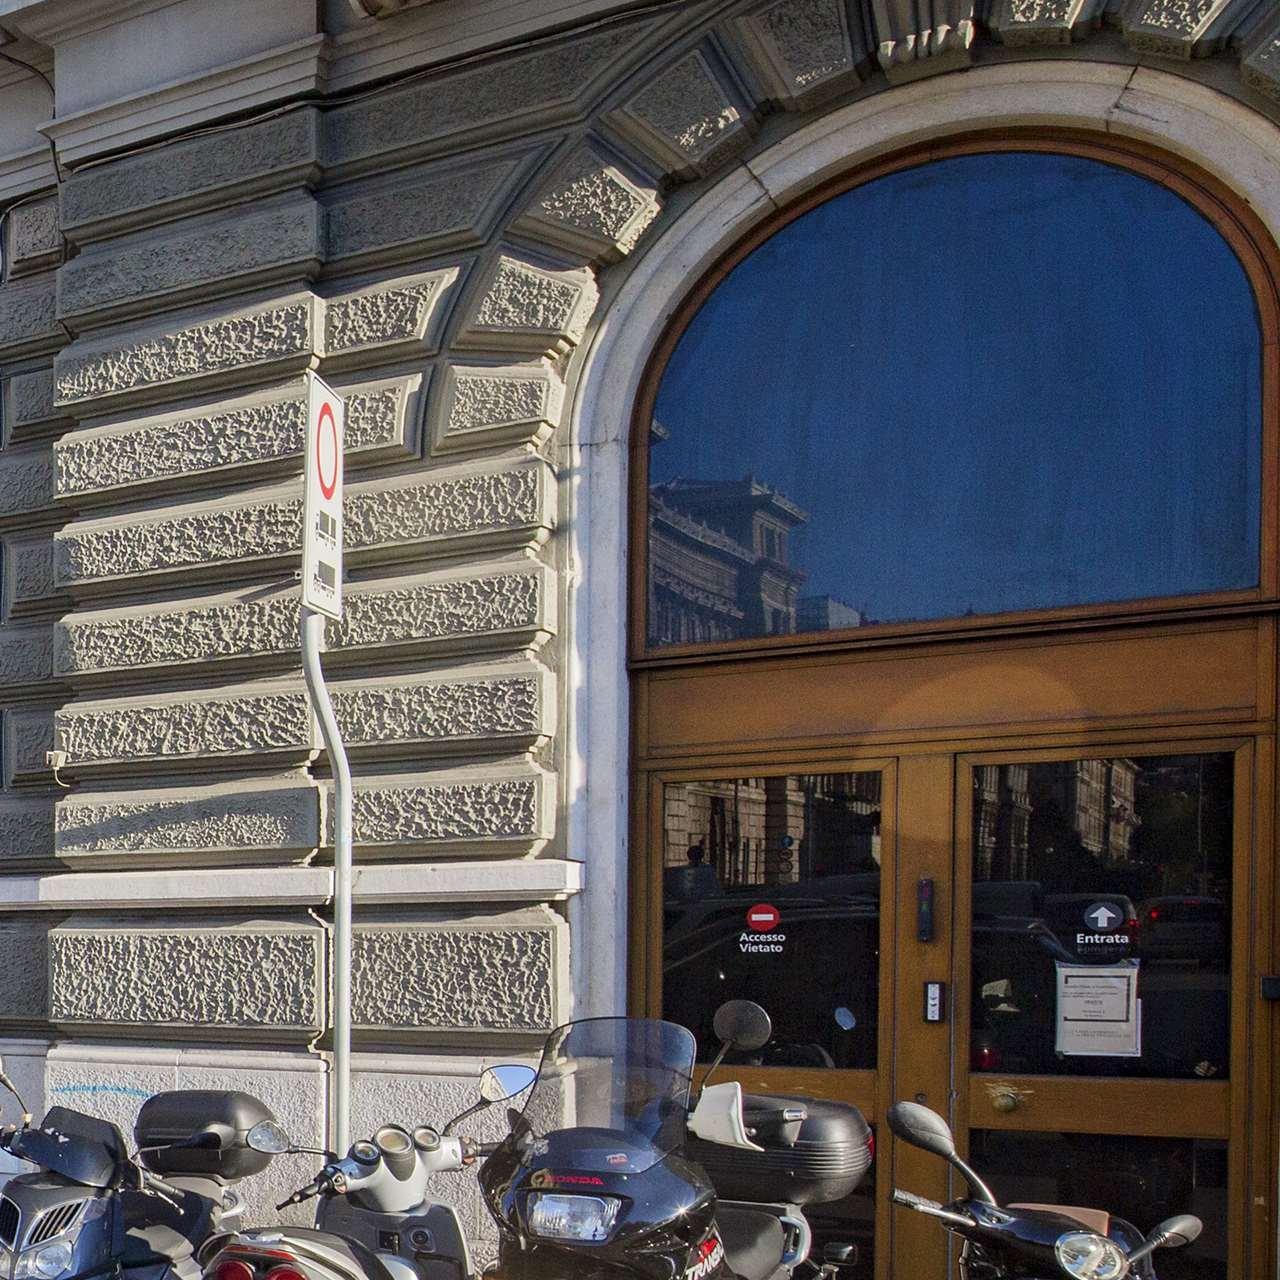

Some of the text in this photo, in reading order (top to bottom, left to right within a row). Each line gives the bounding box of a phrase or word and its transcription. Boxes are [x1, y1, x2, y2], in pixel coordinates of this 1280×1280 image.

[739, 932, 786, 942] Accesso
[1076, 933, 1129, 944] Entrata
[739, 943, 783, 953] Vietato
